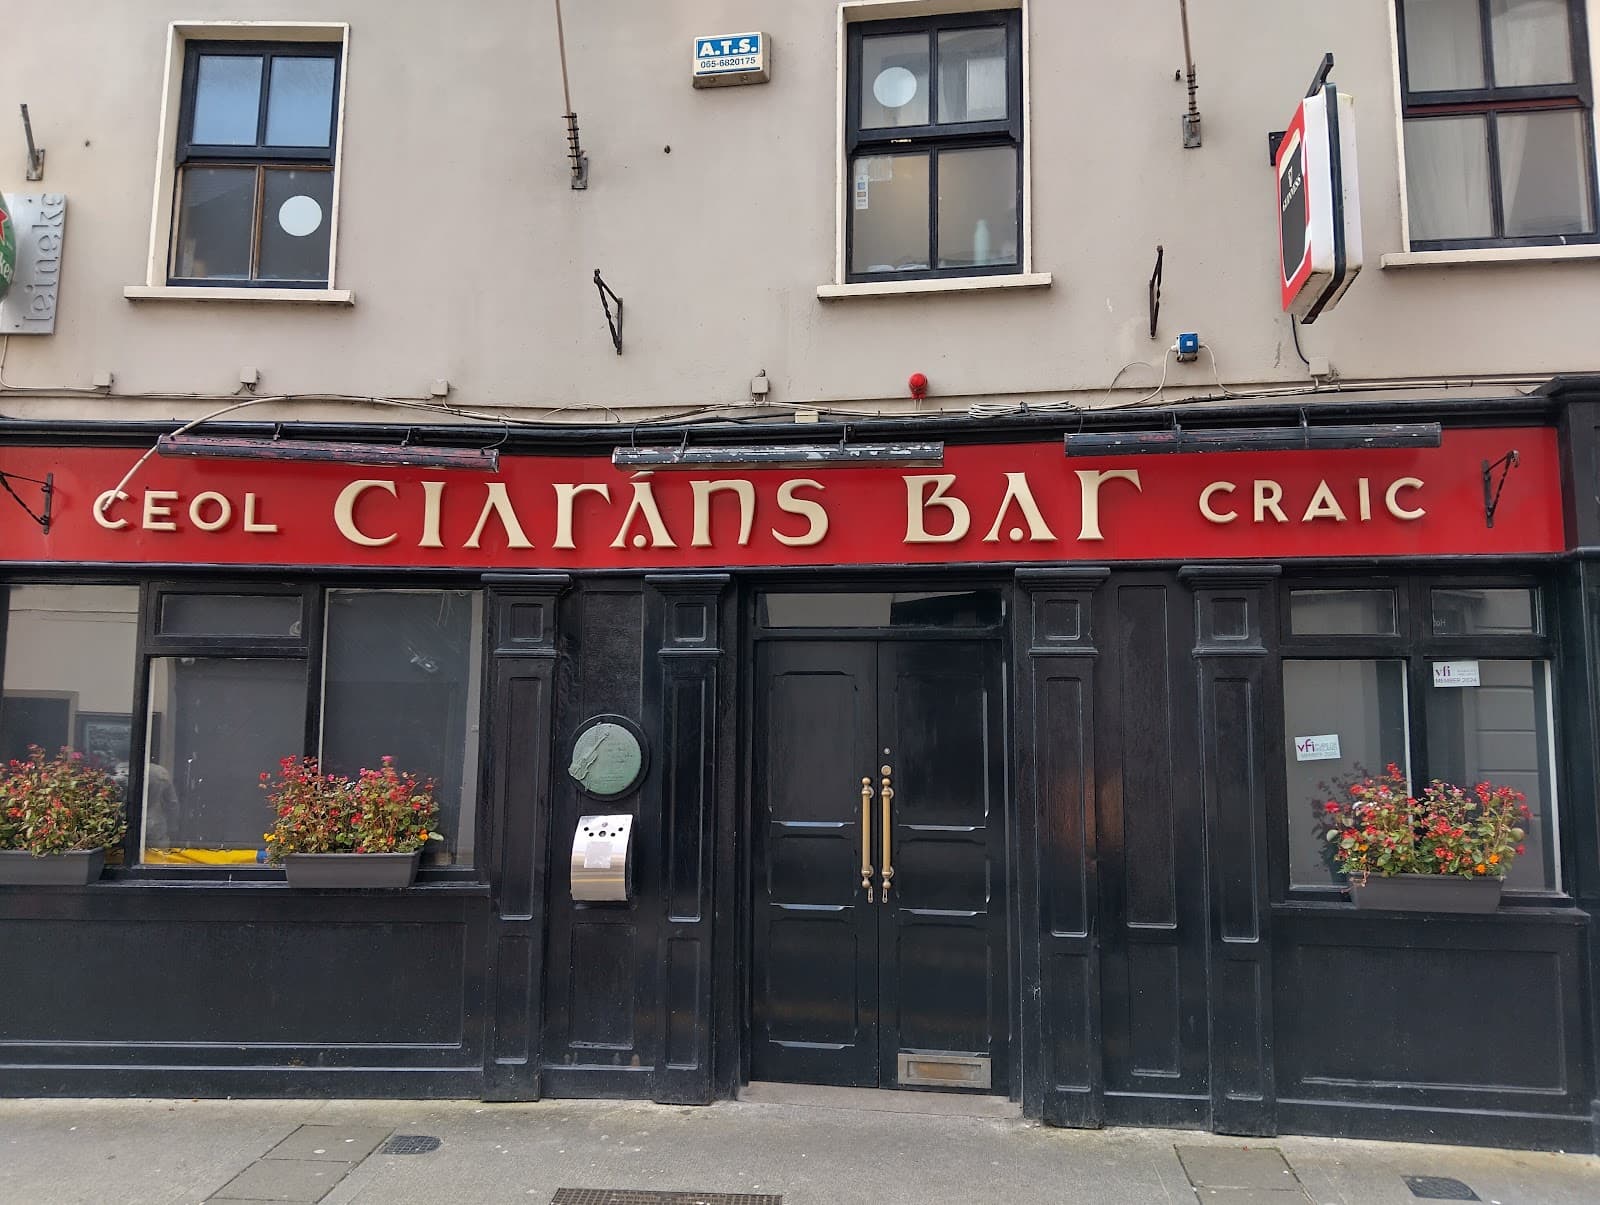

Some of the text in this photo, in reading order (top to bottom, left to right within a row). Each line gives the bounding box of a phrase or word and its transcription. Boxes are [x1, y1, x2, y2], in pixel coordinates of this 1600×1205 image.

[699, 38, 757, 56] A.T.S.
[700, 56, 756, 69] 065-6820175
[92, 489, 278, 533] CEOL
[1199, 477, 1427, 524] CRAIC
[1435, 665, 1451, 677] vfi
[1297, 738, 1315, 753] vfi
